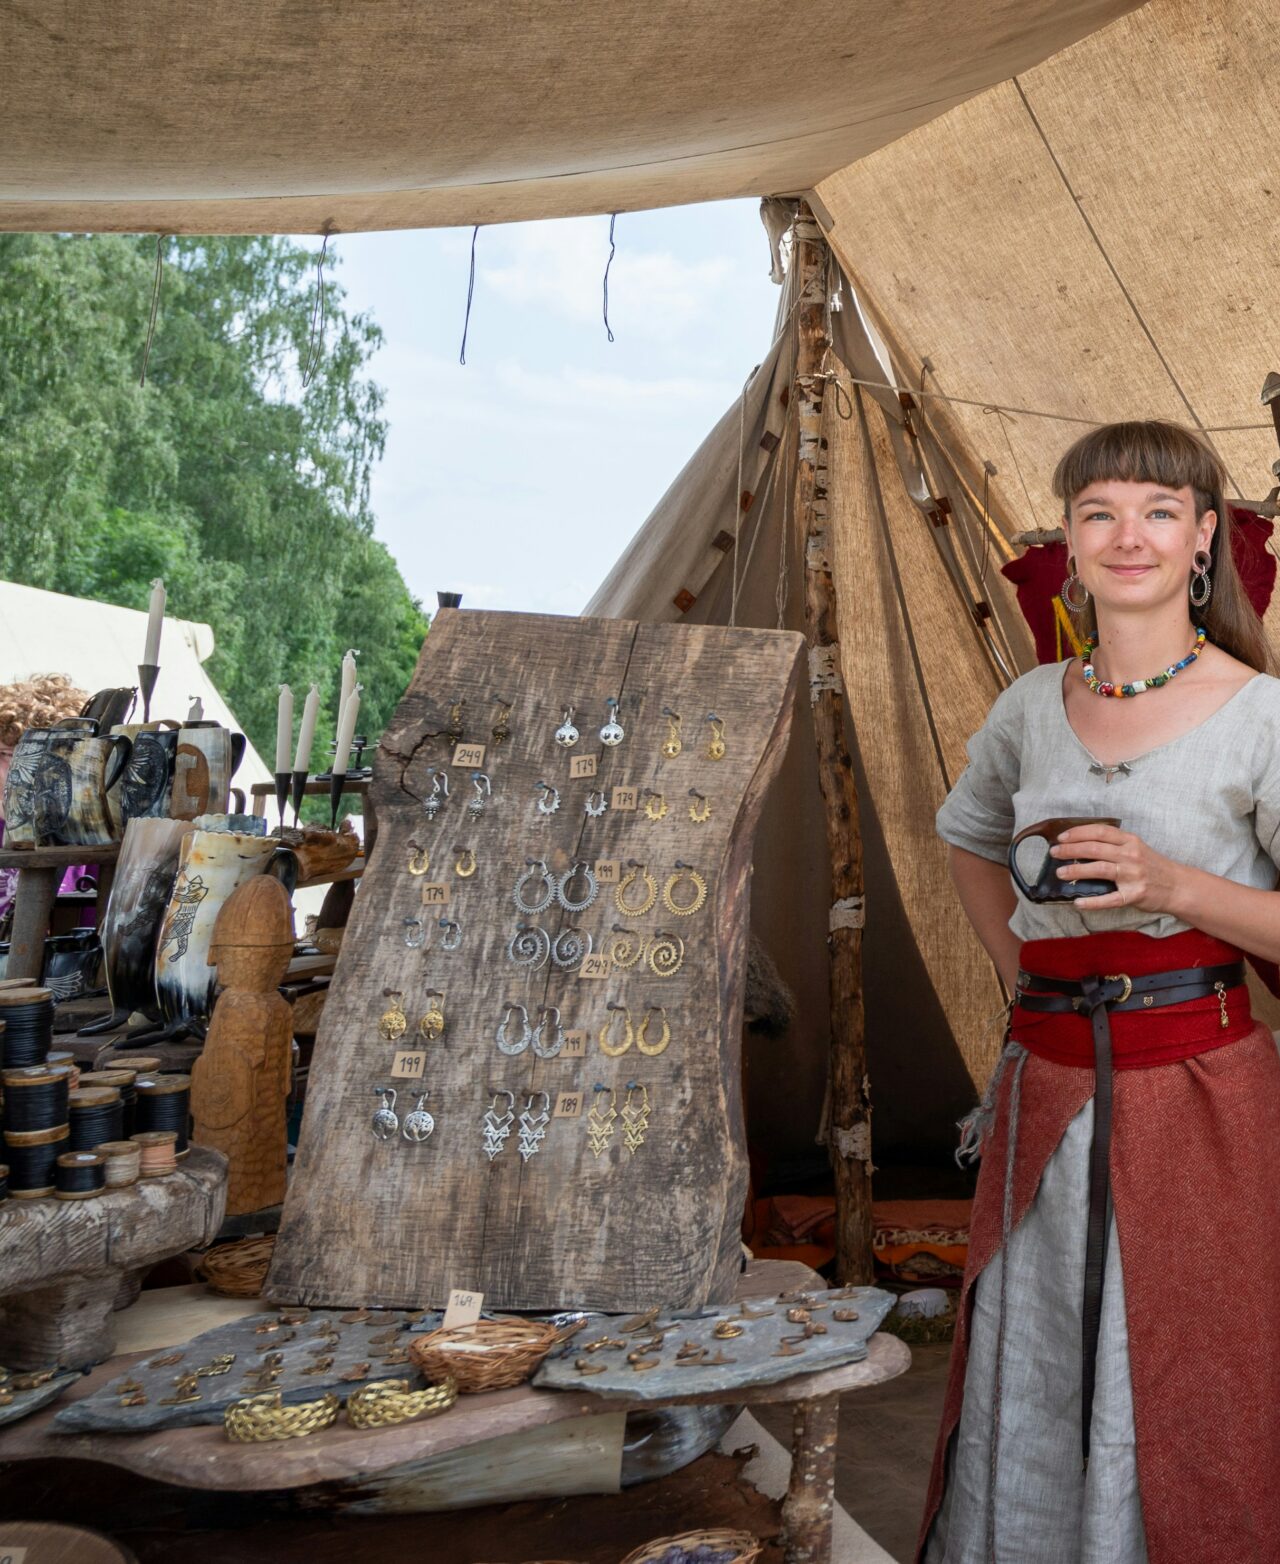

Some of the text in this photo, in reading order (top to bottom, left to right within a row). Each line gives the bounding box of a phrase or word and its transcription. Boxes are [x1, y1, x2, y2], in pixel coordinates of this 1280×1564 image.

[457, 749, 481, 764] 249
[576, 758, 594, 775] 179
[616, 792, 633, 806] 179
[598, 865, 613, 878] 199
[426, 887, 444, 901] 179
[565, 1036, 581, 1051] 199
[400, 1056, 421, 1073] 199
[561, 1097, 578, 1113] 189
